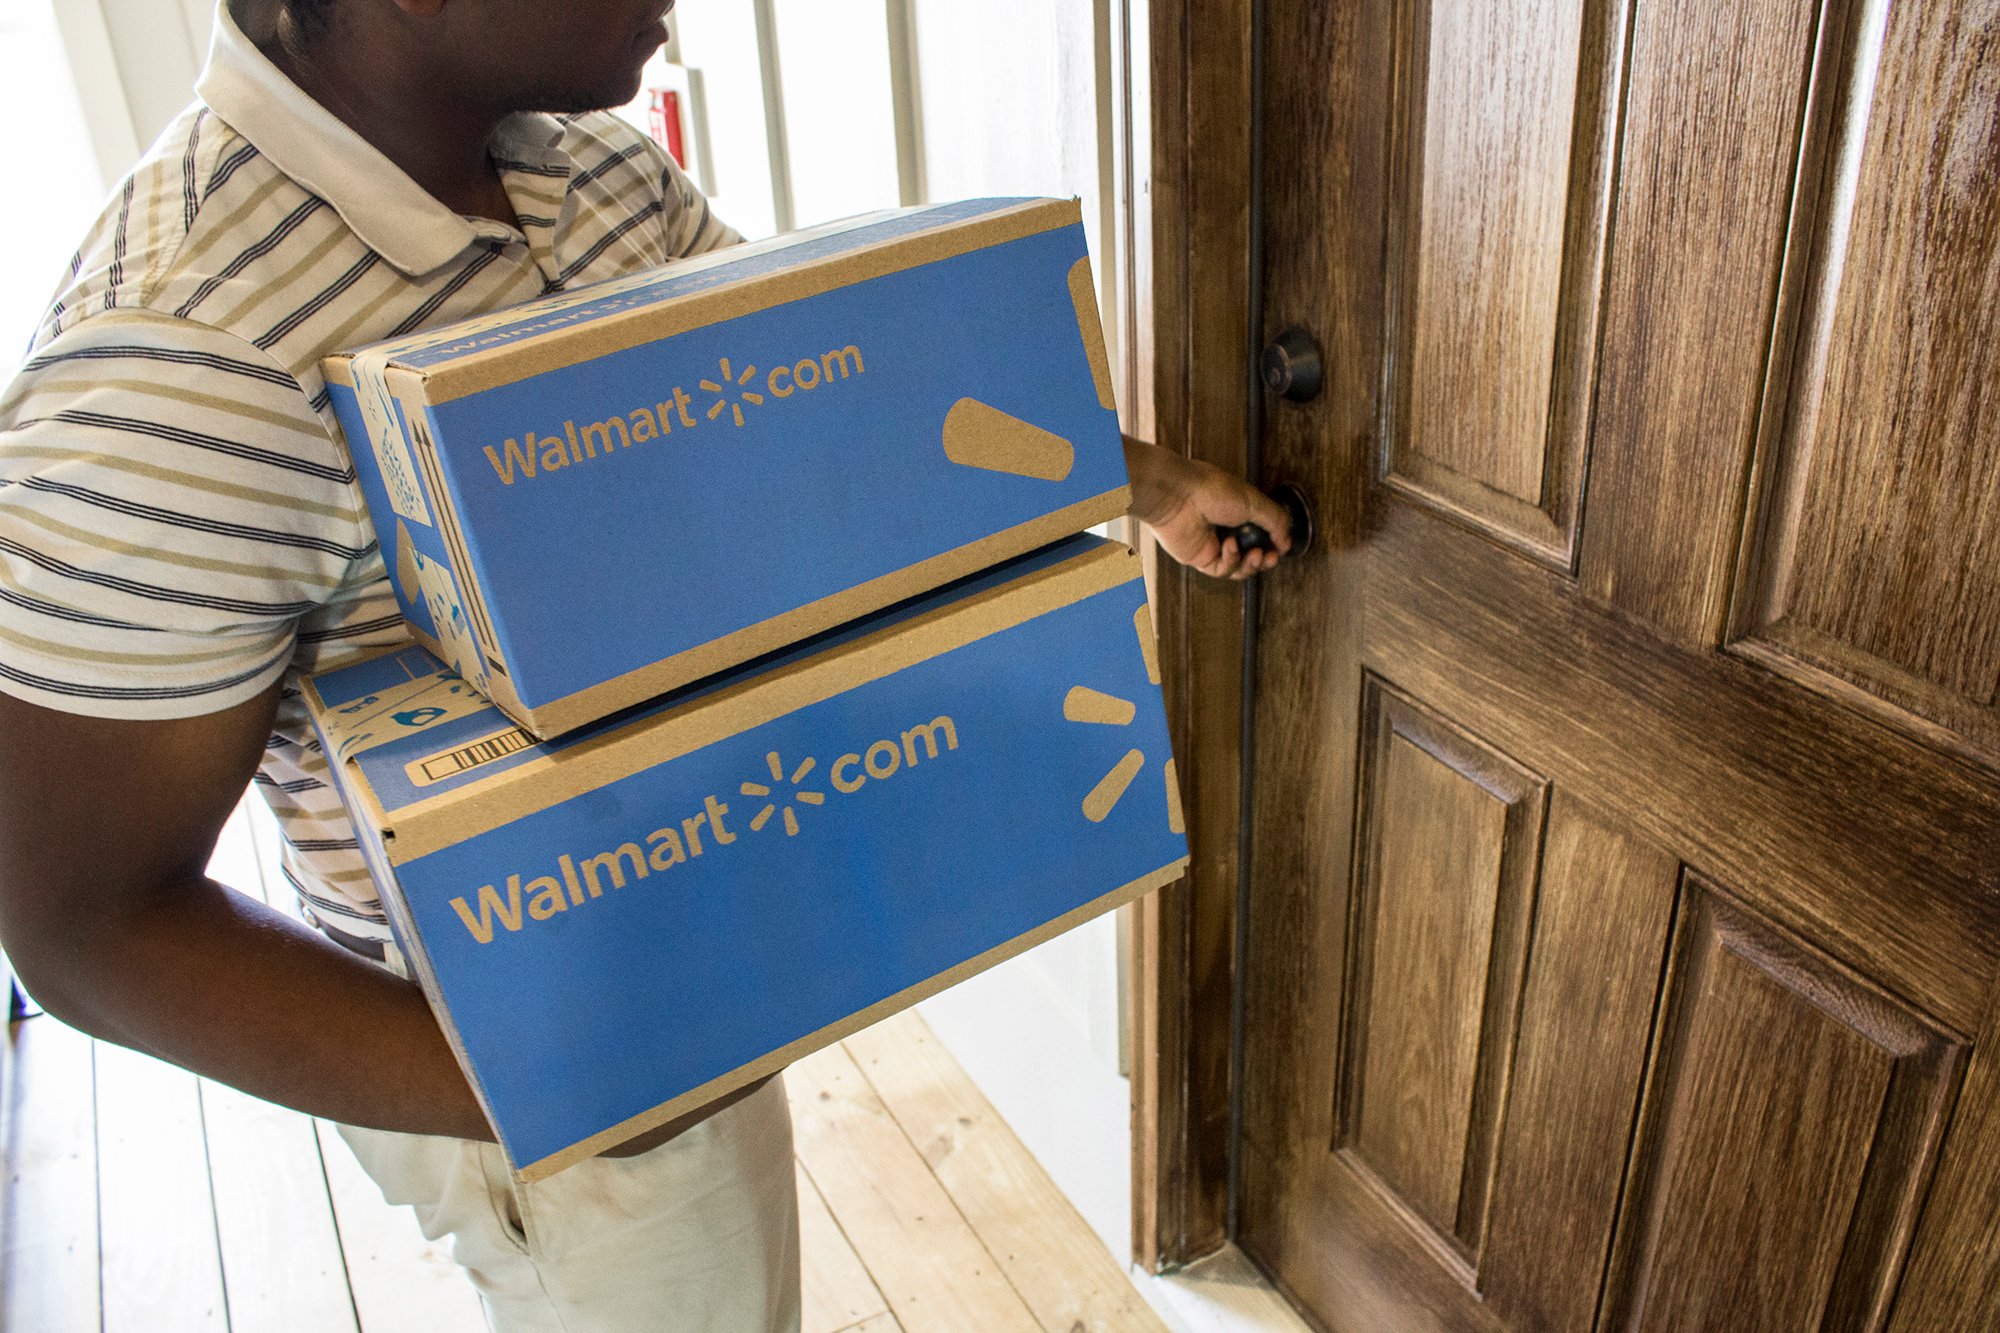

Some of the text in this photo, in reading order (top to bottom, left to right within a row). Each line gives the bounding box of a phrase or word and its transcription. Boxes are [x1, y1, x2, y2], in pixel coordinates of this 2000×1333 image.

[440, 308, 598, 354] Walmart
[483, 388, 697, 485] Walmart
[449, 796, 737, 944] Walmart
